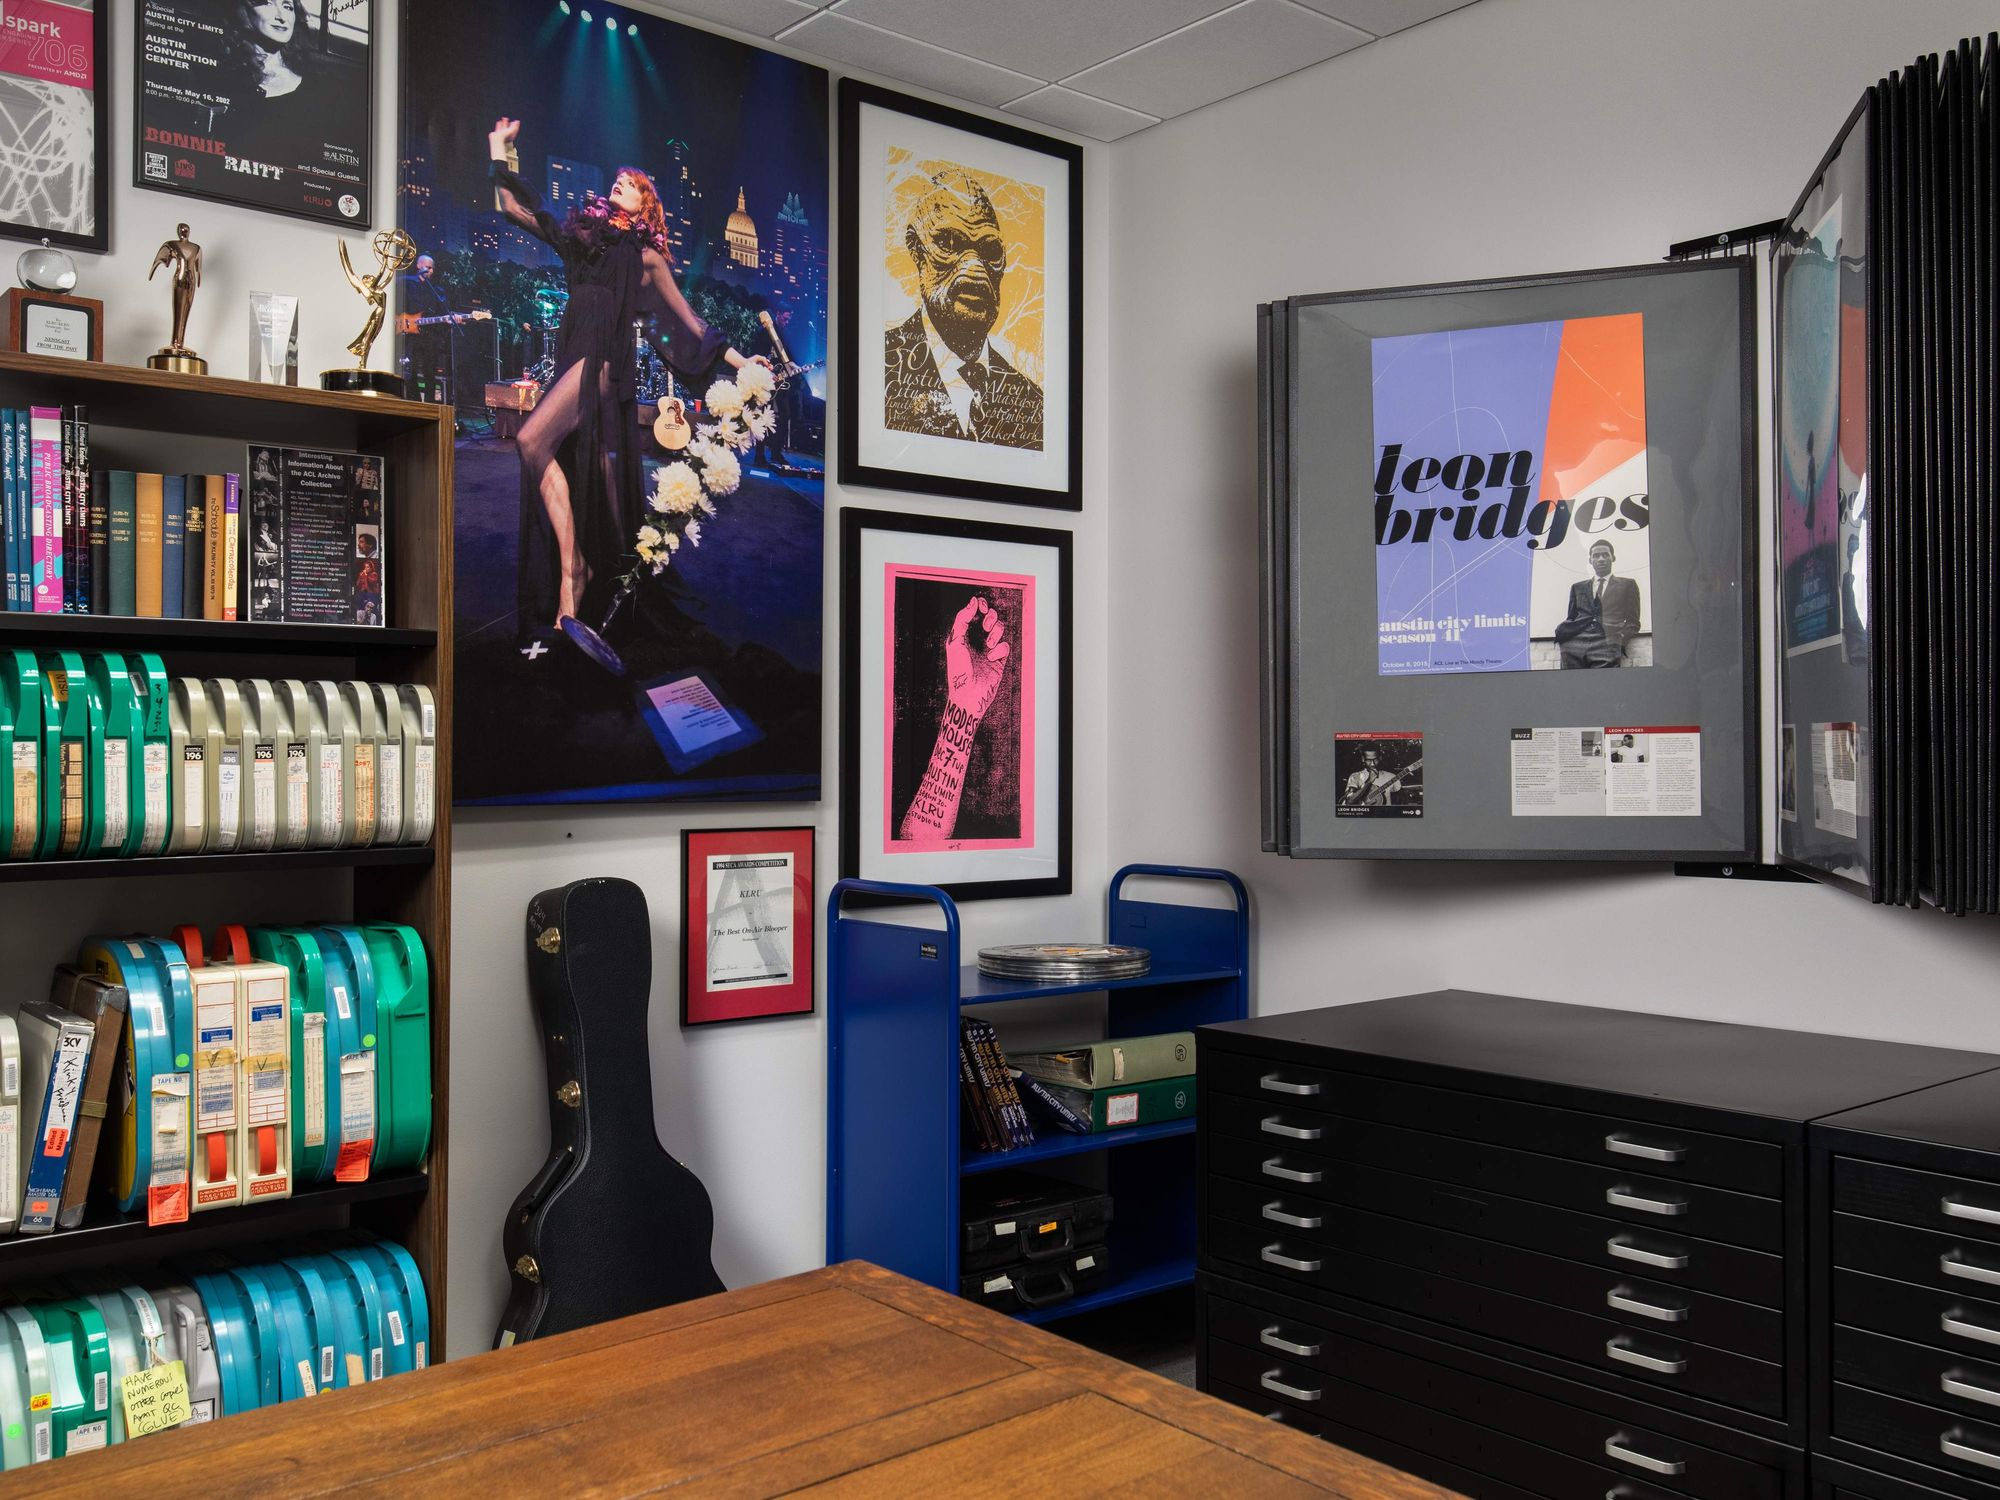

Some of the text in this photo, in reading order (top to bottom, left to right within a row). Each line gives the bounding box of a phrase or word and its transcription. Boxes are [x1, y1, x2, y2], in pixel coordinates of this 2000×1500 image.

[152, 4, 175, 14] Special
[145, 10, 224, 35] AUSTIN CITY LIMITS
[145, 34, 187, 50] AUSTIN
[28, 36, 88, 72] 706
[145, 44, 217, 67] CONVENTION
[145, 53, 190, 70] CENTER
[145, 80, 183, 95] Thursday,
[185, 89, 200, 100] May
[203, 94, 214, 102] 16,
[144, 126, 226, 156] BONNIE
[224, 155, 284, 181] RAITT
[329, 151, 360, 165] AUSTIN
[298, 164, 360, 182] and Special Guests
[303, 181, 324, 190] Produced
[885, 361, 945, 390] Austin
[885, 380, 919, 400] City
[287, 460, 344, 471] Information About
[298, 451, 333, 462] Interesting
[291, 469, 341, 480] the ACL Archive
[1374, 443, 1536, 496] leon
[300, 480, 332, 489] Collection
[45, 479, 53, 537] BROADCASTING
[64, 505, 72, 526] LIMITS
[1375, 485, 1650, 551] bridges
[211, 505, 220, 539] Schedule
[45, 538, 53, 580] DIRECTORY
[228, 537, 236, 590] Carrascolendas
[1379, 613, 1527, 632] austin city limits
[1379, 628, 1460, 645] season 41
[1382, 661, 1405, 669] October
[55, 673, 67, 696] NTSC
[185, 752, 202, 760] 196
[256, 751, 272, 759] 196
[289, 749, 304, 758] 196
[943, 747, 955, 768] 7
[926, 762, 959, 790] AUSTIN
[934, 784, 955, 802] LIMITS
[911, 811, 931, 825] STUDIO
[914, 797, 944, 819] KLRU
[740, 889, 762, 898] KLRU
[713, 924, 788, 937] The Best On-Air Blooper
[966, 1030, 991, 1088] AUSTIN CITY LIMITS
[963, 1061, 976, 1083] LIMITS
[977, 1042, 1005, 1105] AUSTIN CITY LIMITS
[984, 1041, 1011, 1104] AUSTIN CITY LIMITS
[993, 1040, 1021, 1104] AUSTIN CITY LIMITS
[1031, 1082, 1078, 1123] AUSTIN CITY LIMITS
[47, 1130, 58, 1150] Edited
[56, 1130, 66, 1152] Master
[125, 1371, 153, 1386] HAVE
[127, 1373, 173, 1400] NUMEROUS
[130, 1396, 156, 1411] OTHER
[162, 1402, 180, 1414] QC
[138, 1407, 185, 1434] (GLUE)
